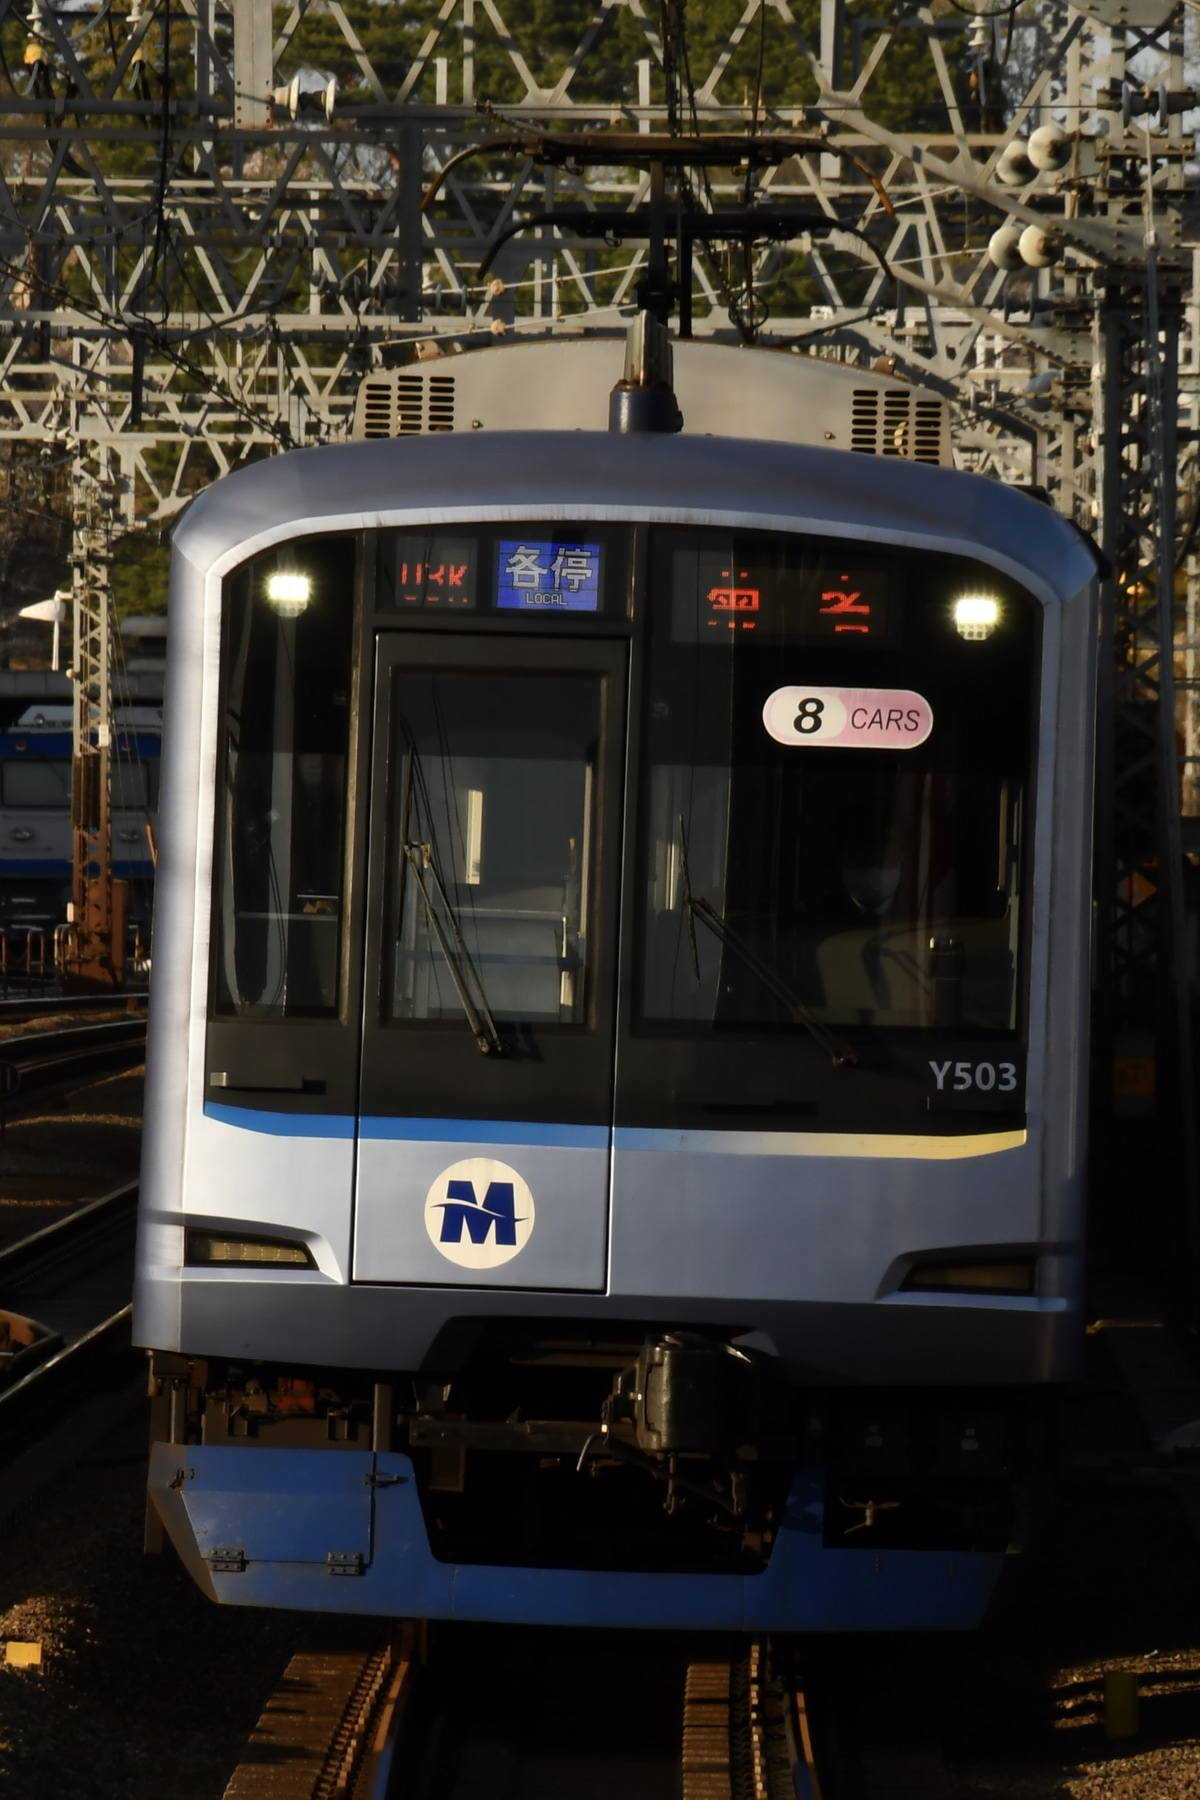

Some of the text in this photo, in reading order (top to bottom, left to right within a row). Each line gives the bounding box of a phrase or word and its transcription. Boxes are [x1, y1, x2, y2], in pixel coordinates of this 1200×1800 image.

[505, 545, 593, 592] 各停
[526, 592, 568, 605] LOCAL
[793, 697, 920, 734] 8 CARS
[928, 1060, 1017, 1091] Y503
